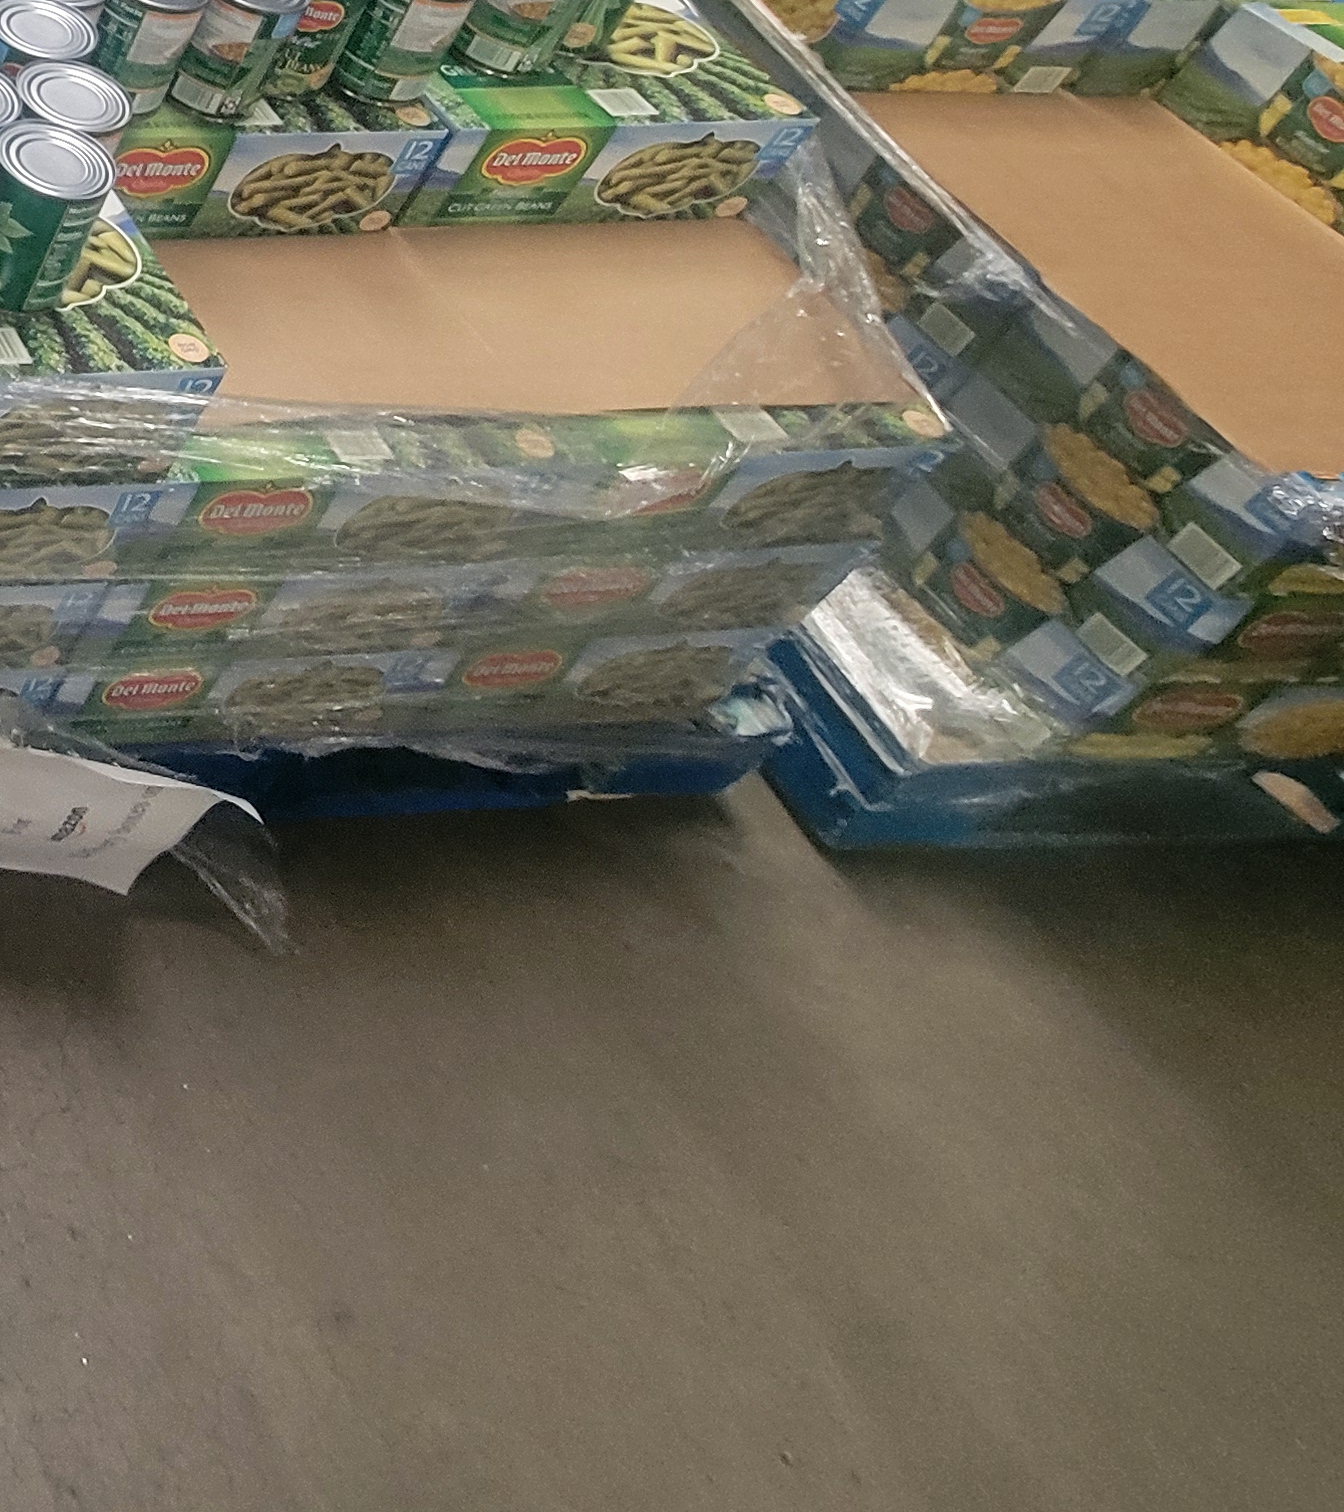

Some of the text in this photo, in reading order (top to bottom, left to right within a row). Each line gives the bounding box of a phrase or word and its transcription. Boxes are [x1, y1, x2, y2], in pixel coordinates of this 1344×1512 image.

[771, 127, 803, 148] 12
[404, 140, 434, 160] 12
[492, 150, 578, 167] Del Monte
[116, 162, 201, 177] Del Monte
[151, 212, 187, 224] BEANS
[120, 492, 150, 511] 12
[210, 502, 304, 519] Del Monte
[1171, 587, 1201, 612] 12
[1073, 662, 1108, 689] 12
[111, 679, 196, 698] Del Monte
